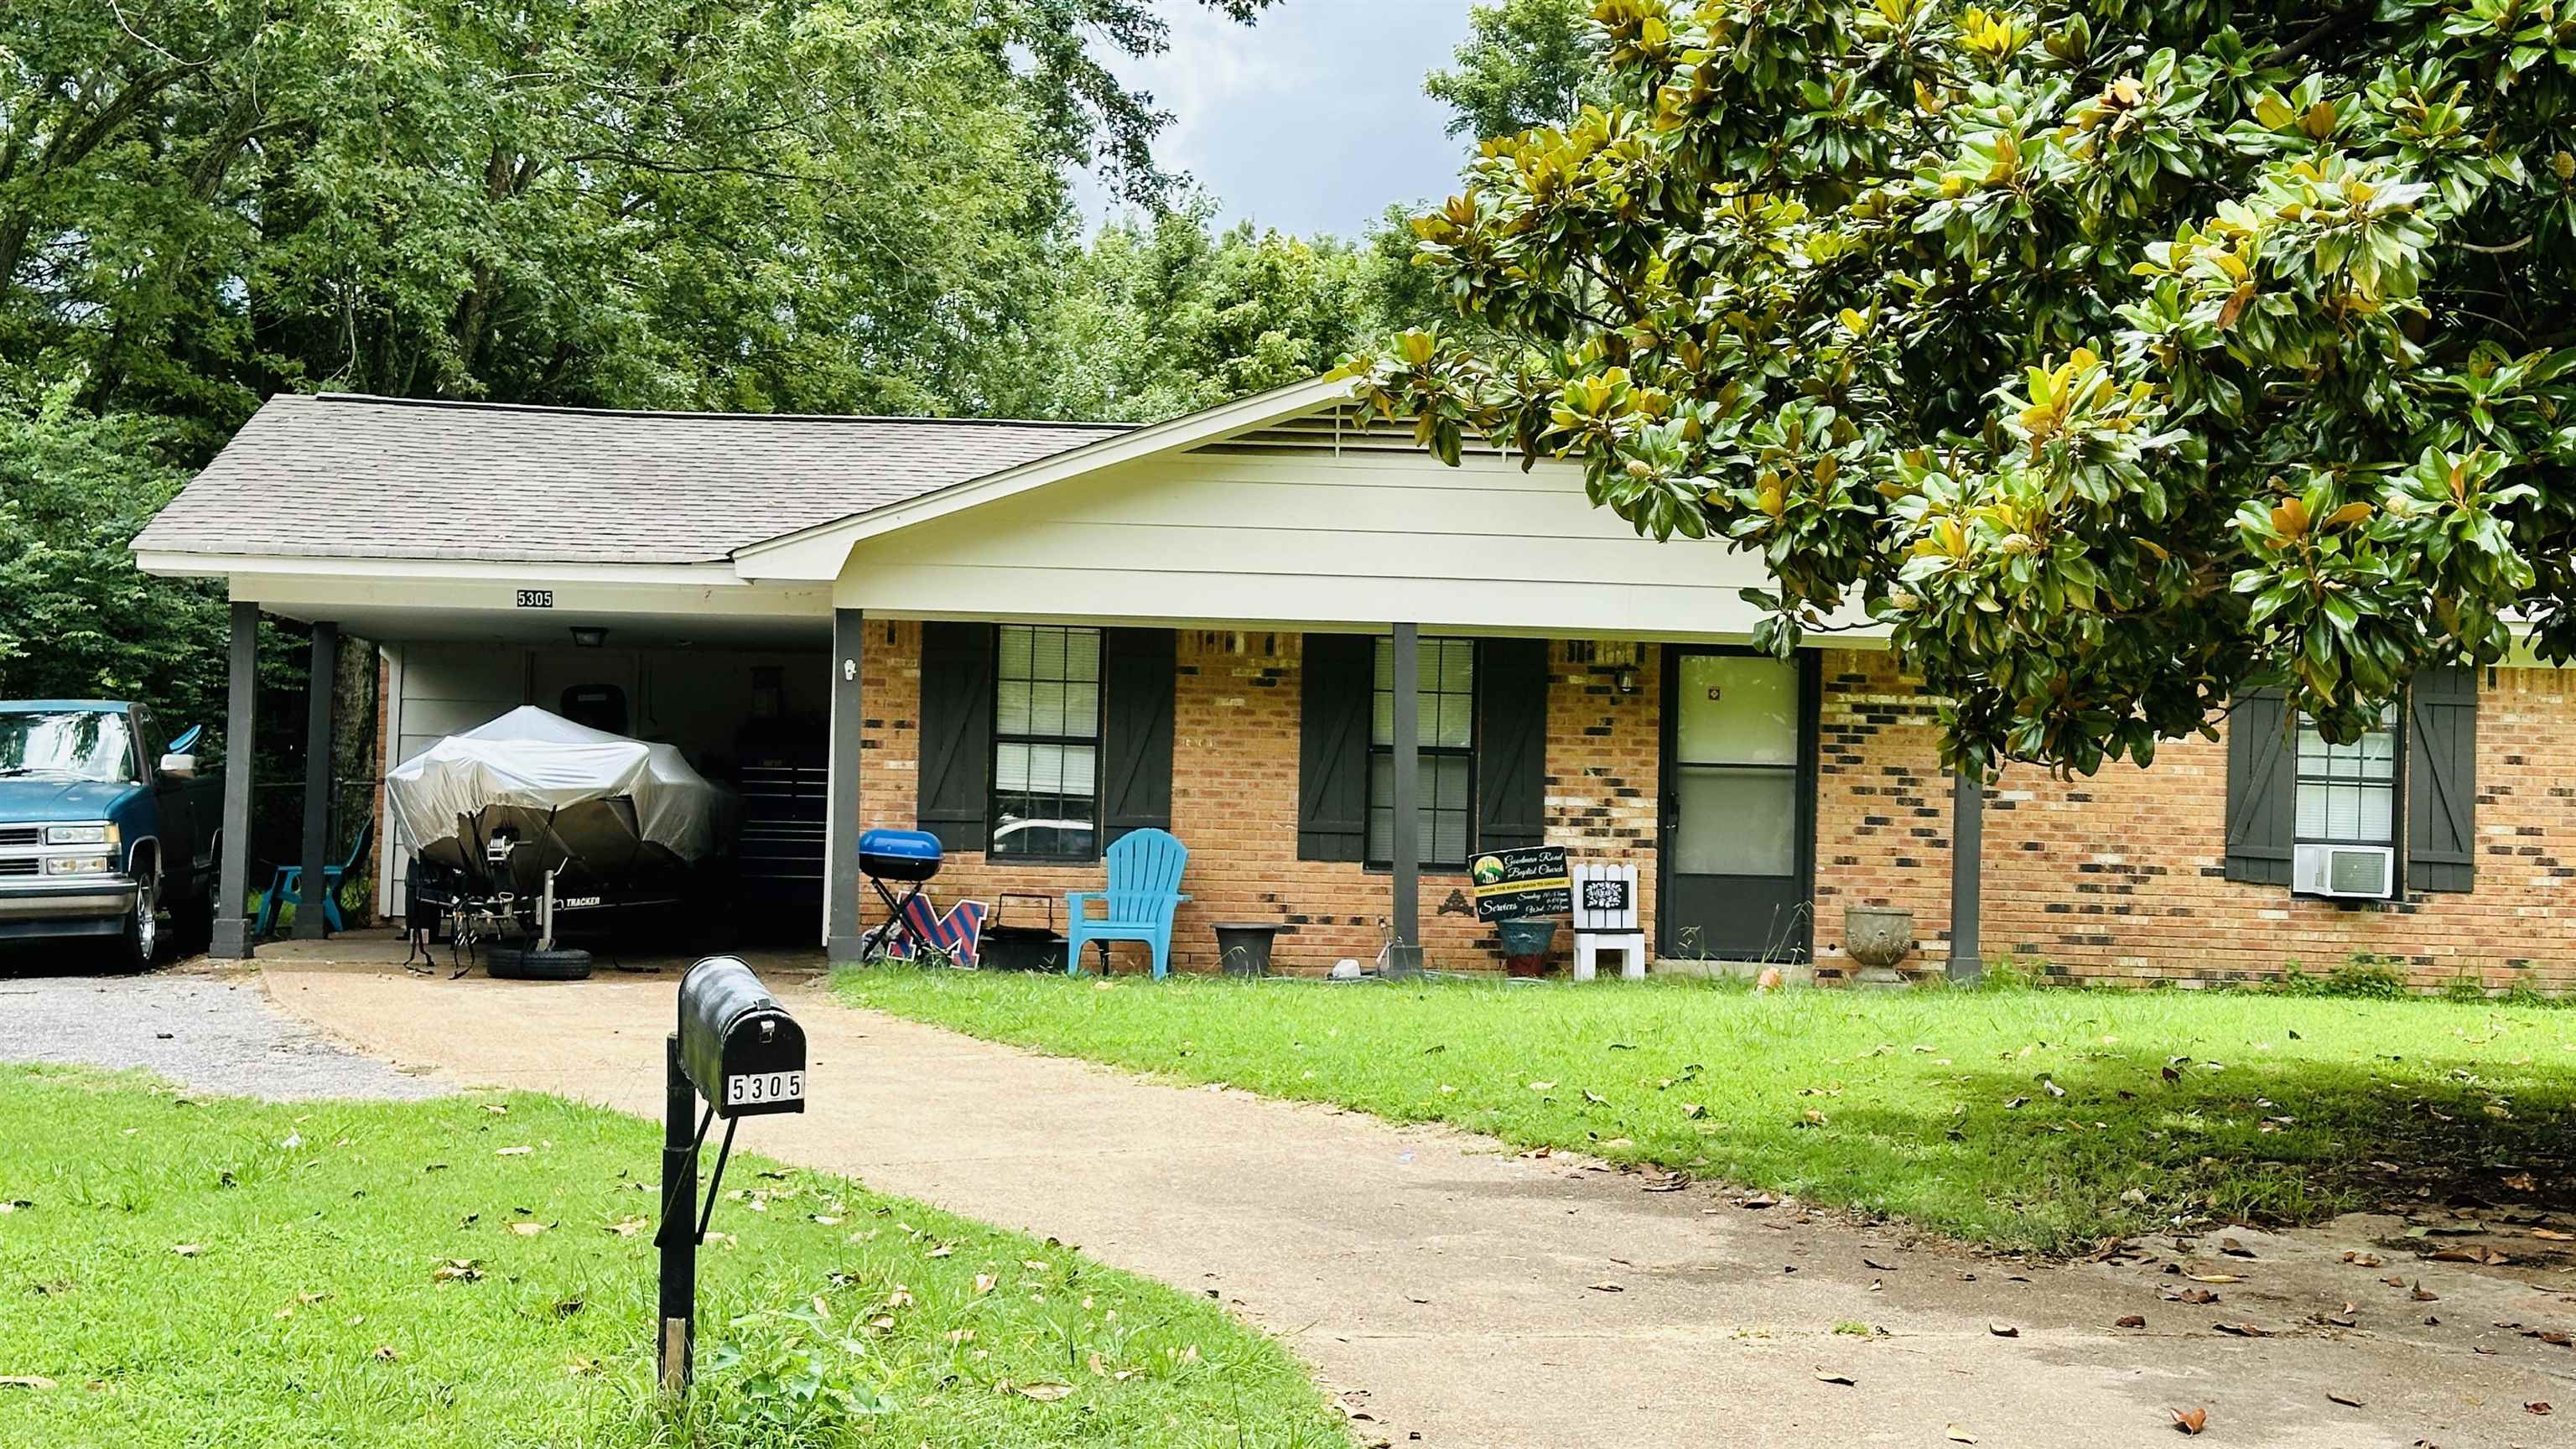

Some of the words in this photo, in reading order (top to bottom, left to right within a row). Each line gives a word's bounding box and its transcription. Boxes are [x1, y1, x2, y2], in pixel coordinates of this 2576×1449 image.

[517, 591, 552, 605] 5305
[1539, 851, 1564, 863] Road
[1508, 866, 1536, 879] Baptist
[1538, 864, 1564, 875] Church
[566, 896, 600, 907] TRACKER
[1517, 893, 1541, 901] Sunday
[1479, 900, 1518, 914] Services
[733, 1075, 800, 1100] 5305
